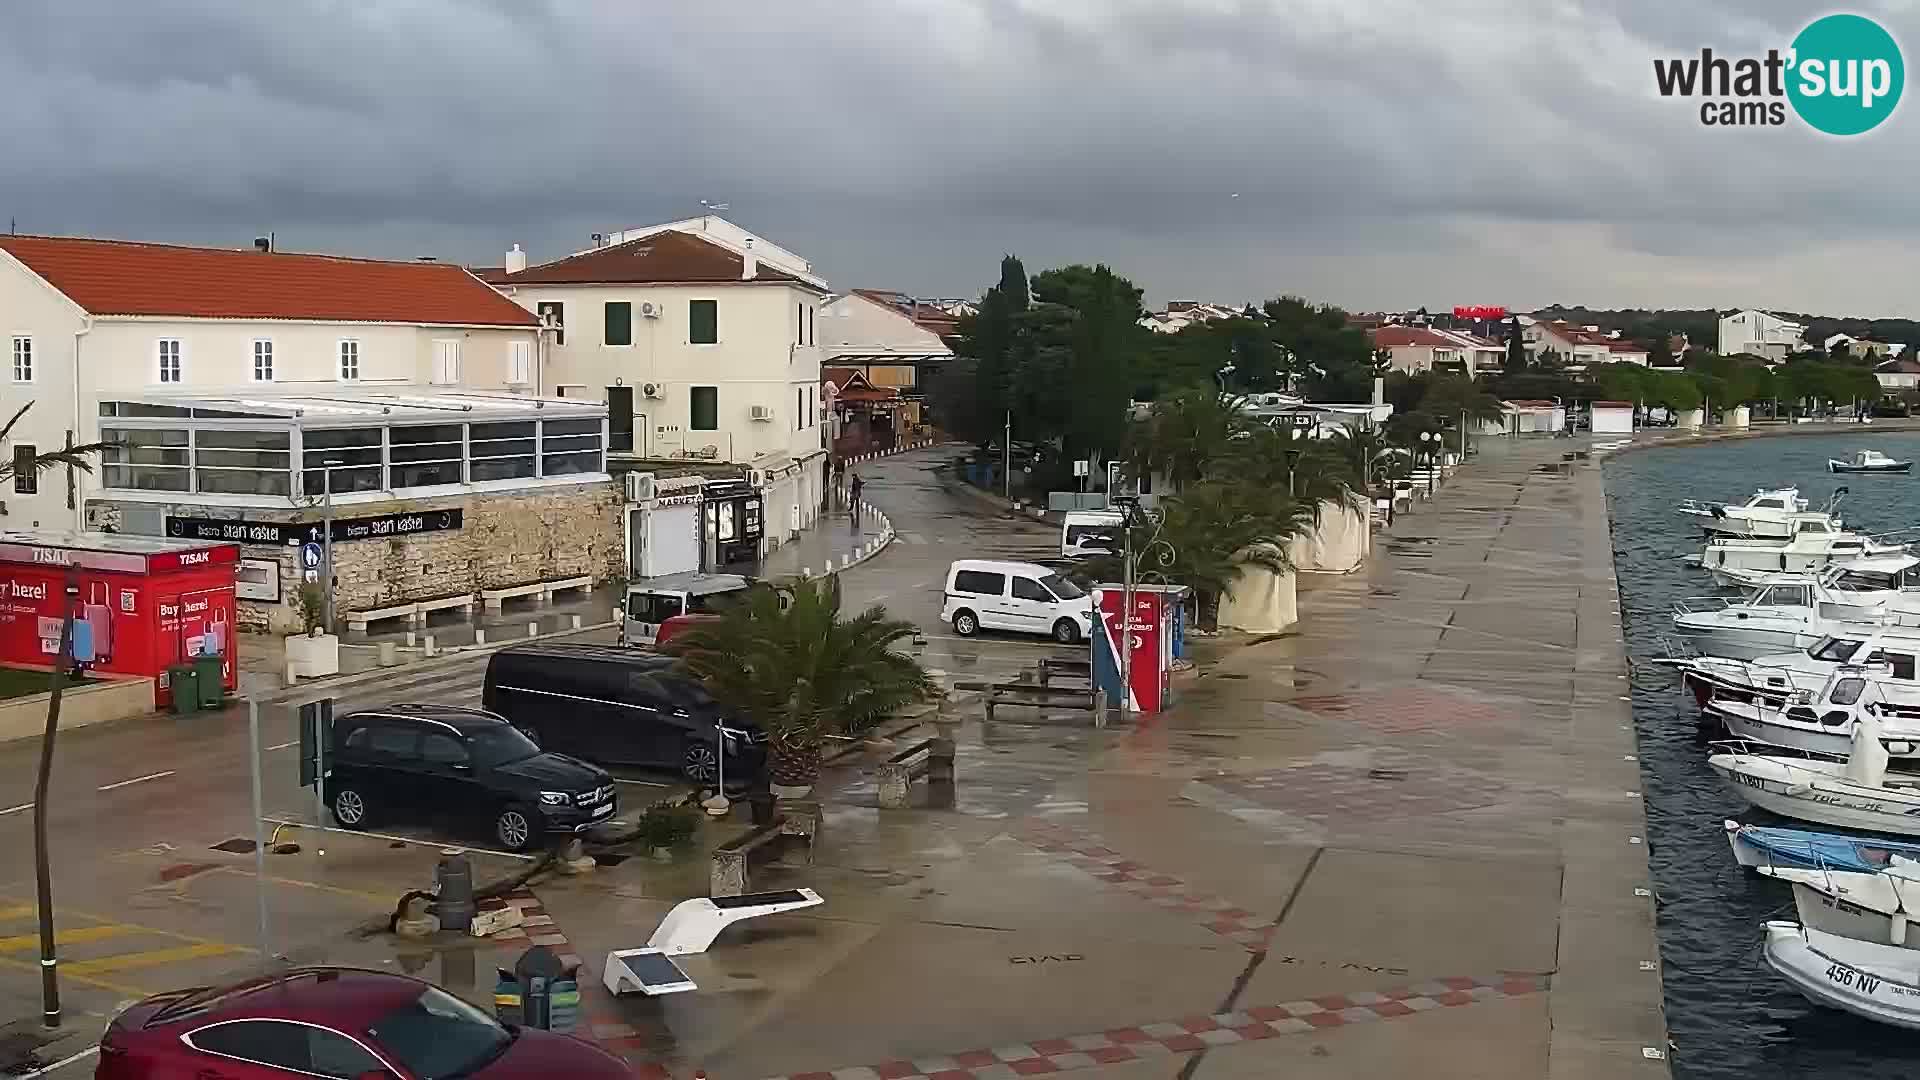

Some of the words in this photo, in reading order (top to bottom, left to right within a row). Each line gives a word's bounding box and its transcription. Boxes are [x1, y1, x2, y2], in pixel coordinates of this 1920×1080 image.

[180, 551, 210, 565] TISAK
[11, 579, 47, 600] here!
[160, 604, 180, 617] Buy
[184, 597, 208, 613] here!
[1825, 964, 1855, 986] 456
[1855, 974, 1881, 995] NV
